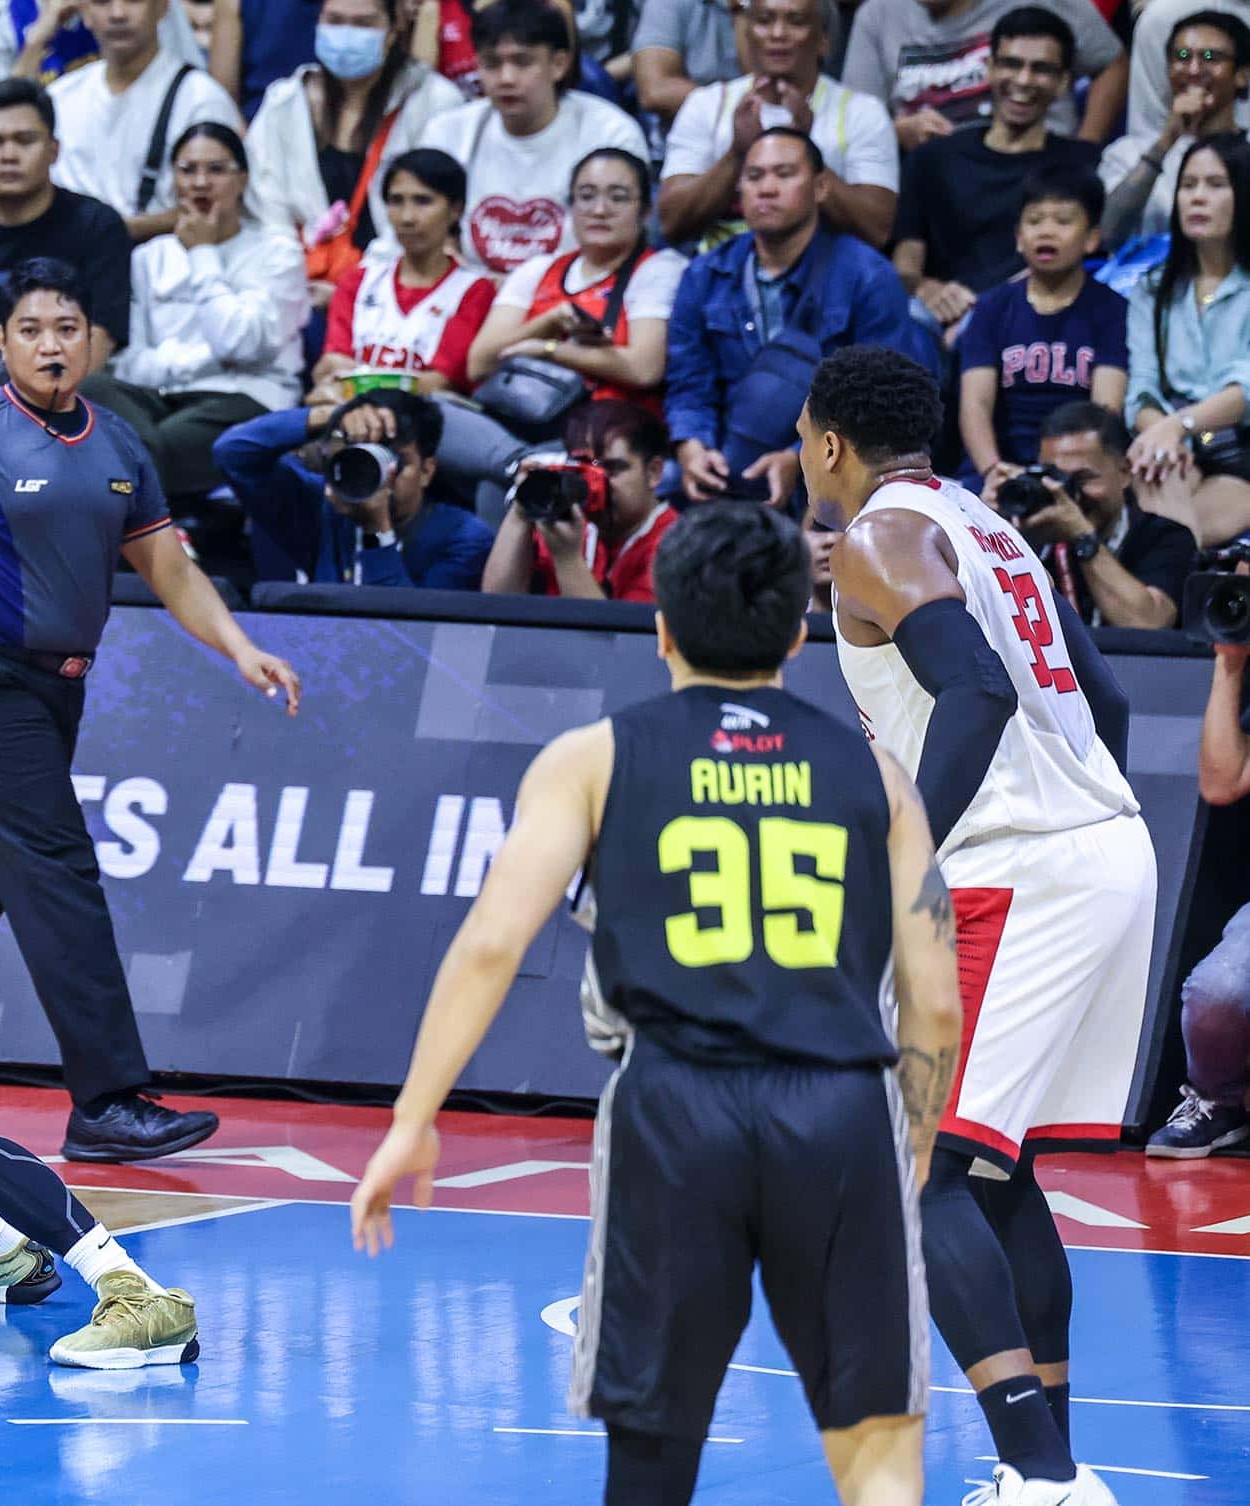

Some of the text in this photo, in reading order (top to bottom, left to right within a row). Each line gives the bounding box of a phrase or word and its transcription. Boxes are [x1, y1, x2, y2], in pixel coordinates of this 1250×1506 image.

[991, 566, 1078, 695] 32
[183, 782, 394, 893] ALL
[690, 757, 812, 808] AURIN
[657, 815, 848, 969] 35
